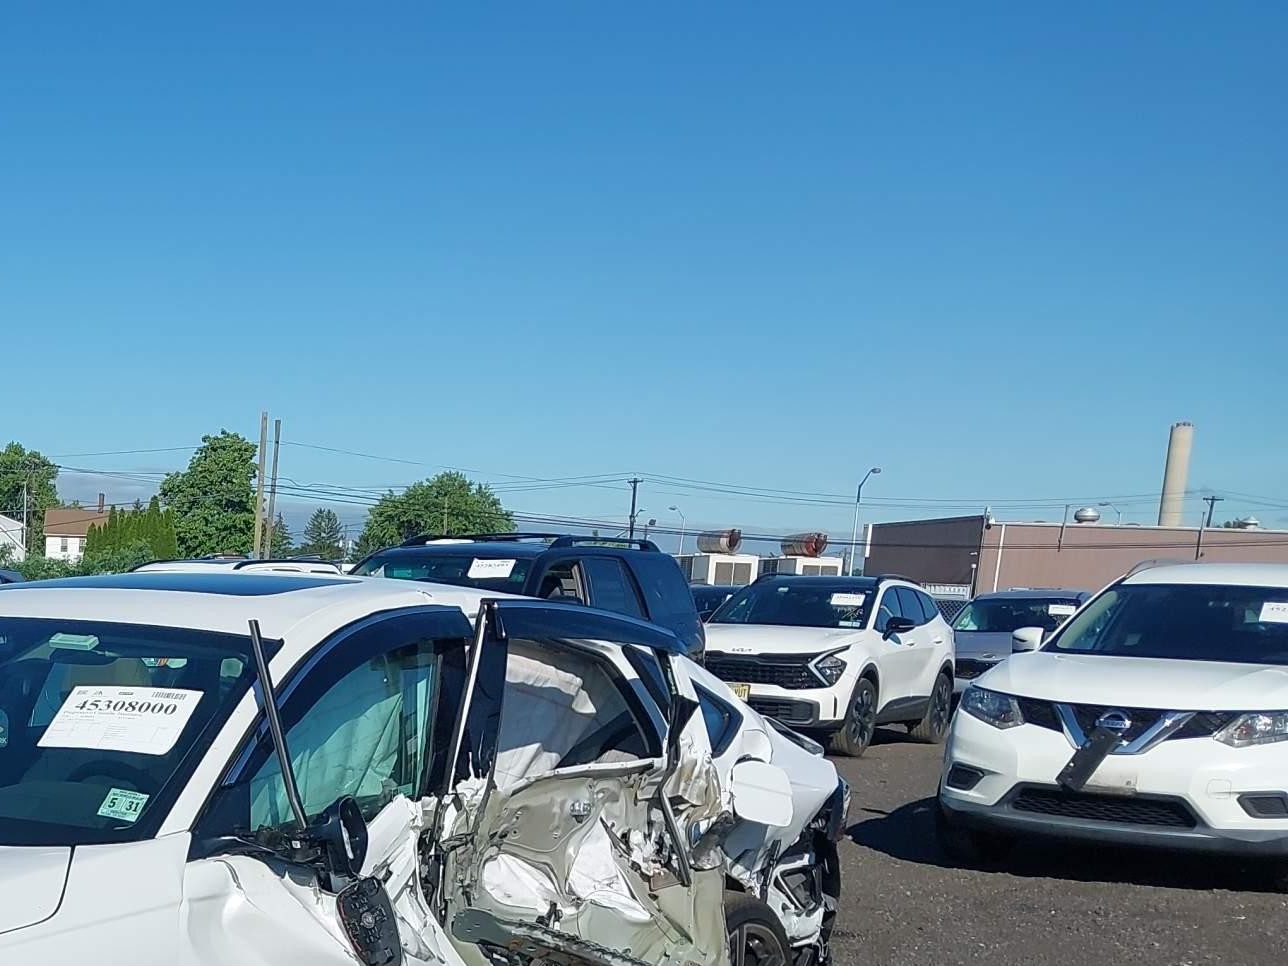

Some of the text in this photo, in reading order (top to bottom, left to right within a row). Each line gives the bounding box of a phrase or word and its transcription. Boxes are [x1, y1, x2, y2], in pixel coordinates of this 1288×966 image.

[74, 699, 178, 716] 45308000
[107, 797, 140, 812] 5 31
